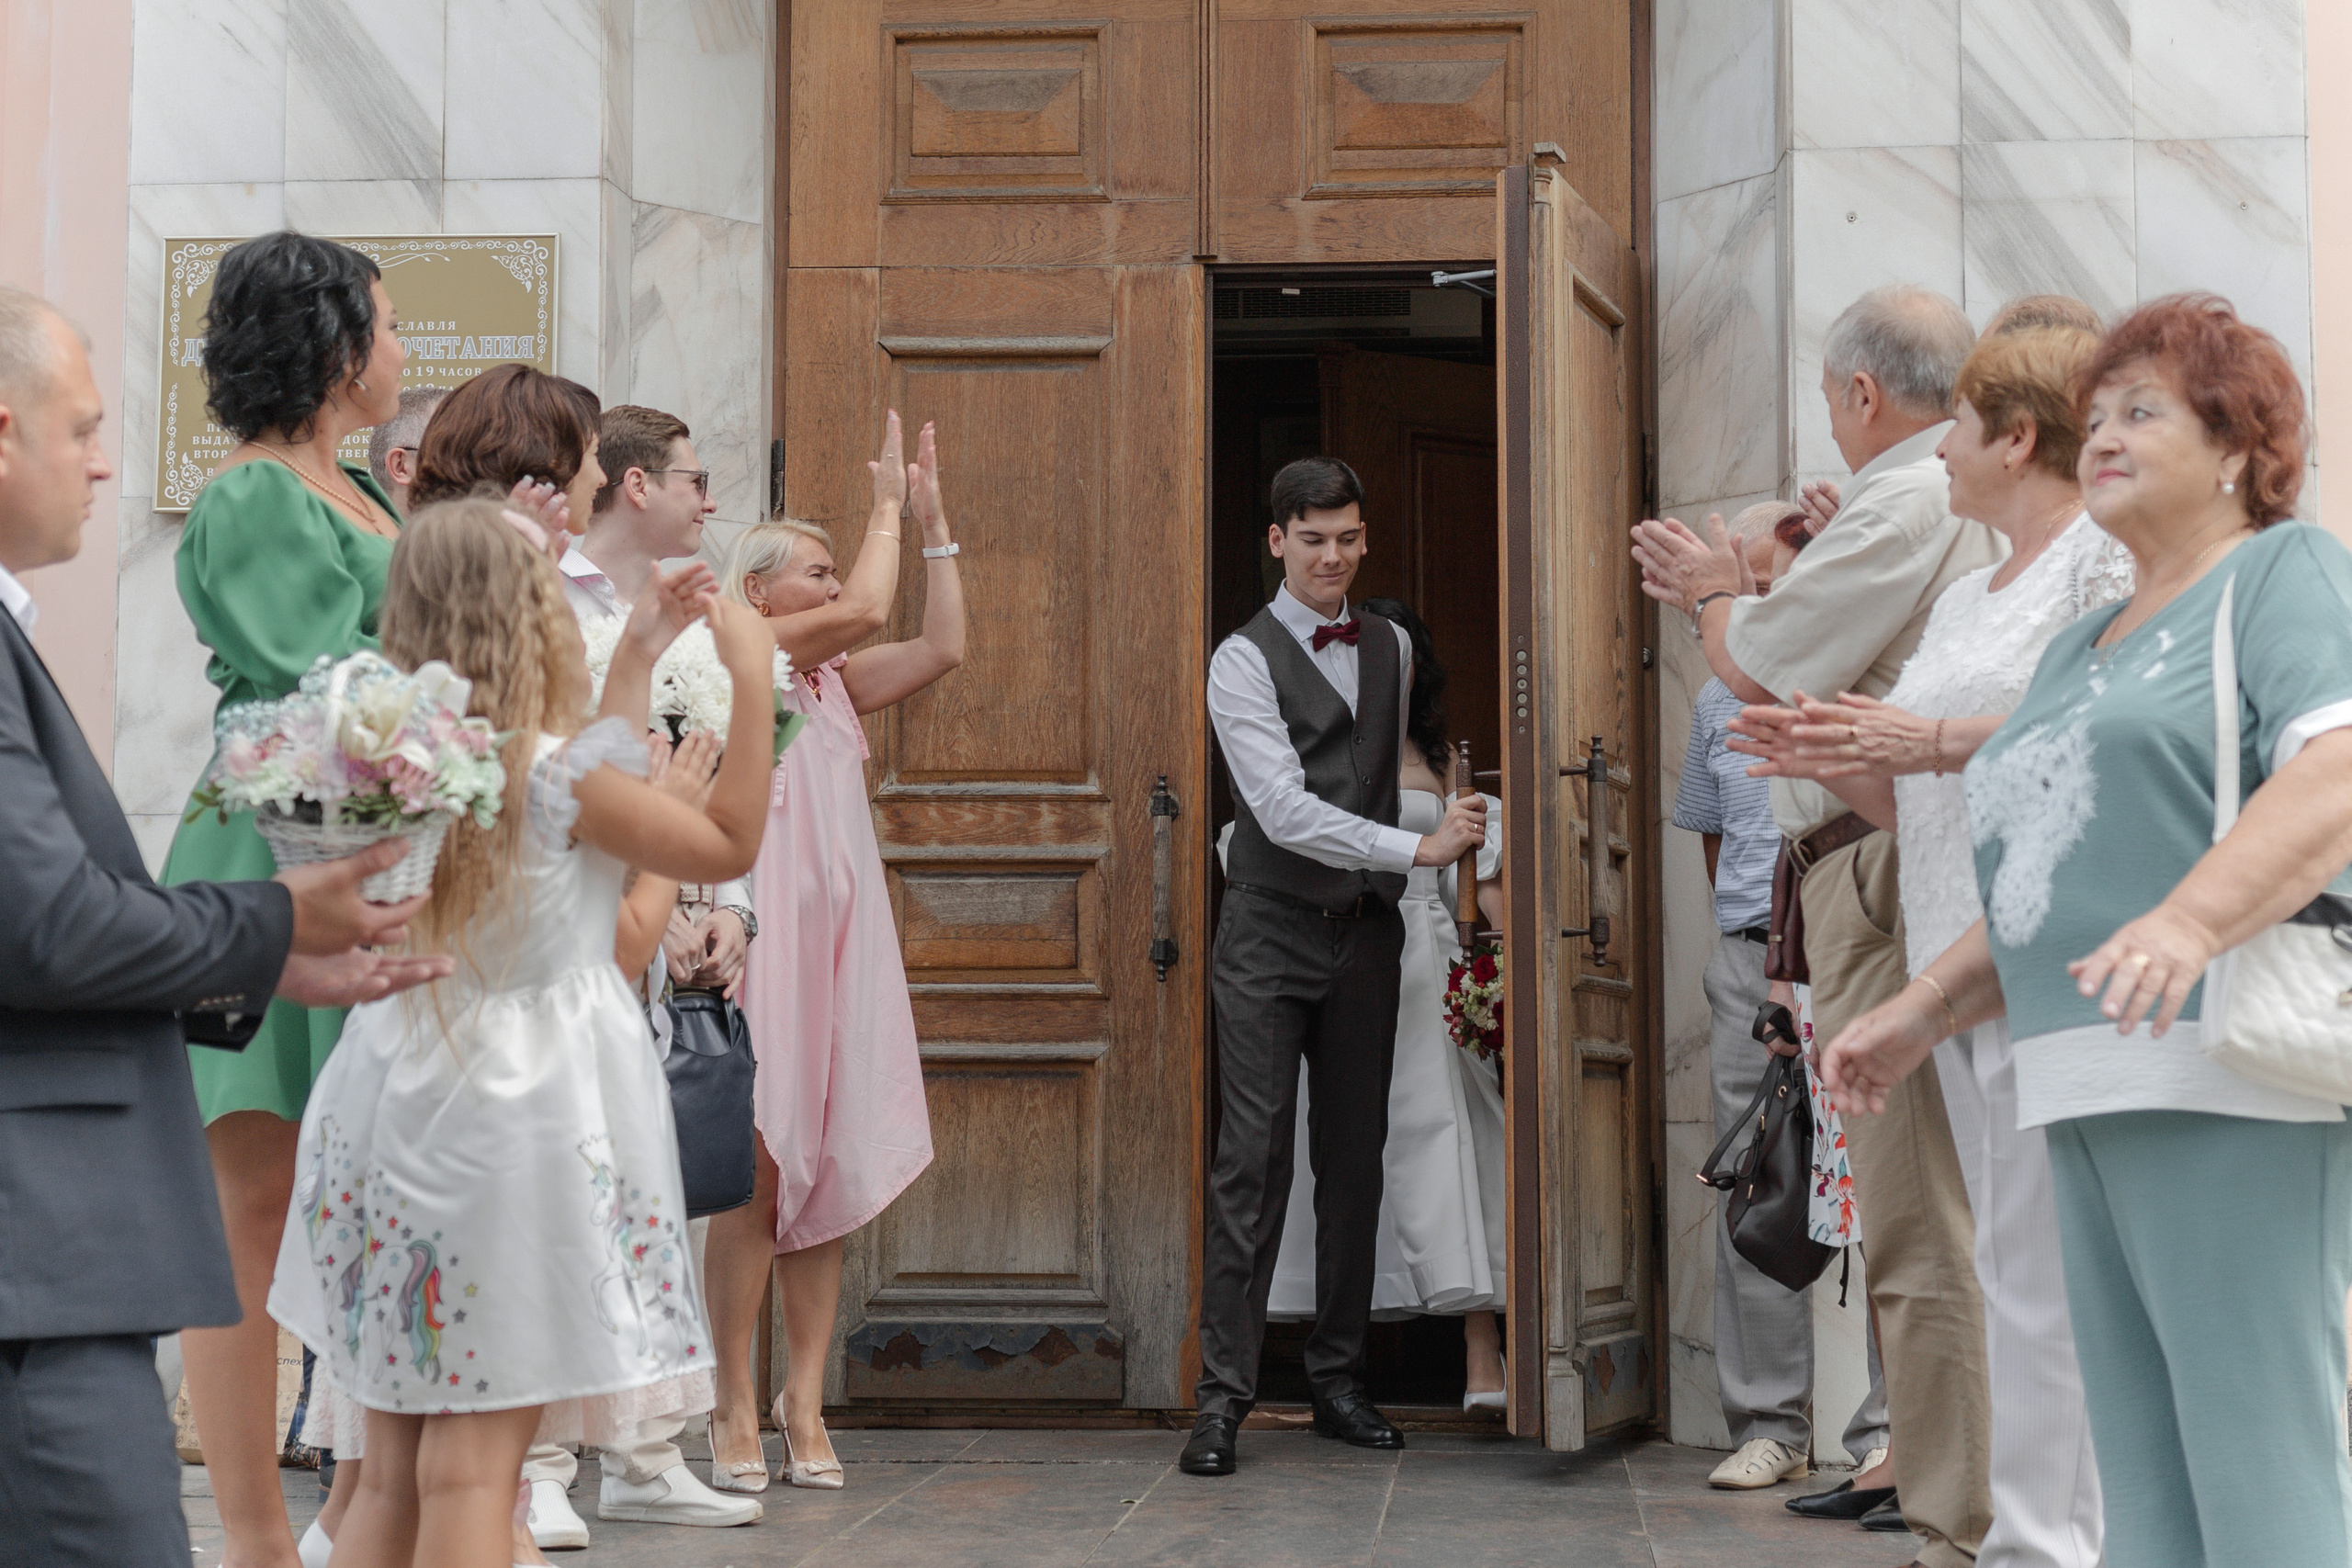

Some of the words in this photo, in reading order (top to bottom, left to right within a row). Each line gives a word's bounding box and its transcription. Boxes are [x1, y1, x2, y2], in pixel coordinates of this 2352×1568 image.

[396, 321, 457, 331] СЛАВЛЯ
[397, 335, 535, 360] ОЧЕТАНИЯ
[415, 366, 435, 377] 19
[192, 435, 238, 446] ВЫДАЧ
[194, 449, 228, 458] ВТОР
[336, 448, 369, 458] ТВЕР
[277, 1357, 303, 1366] спех
